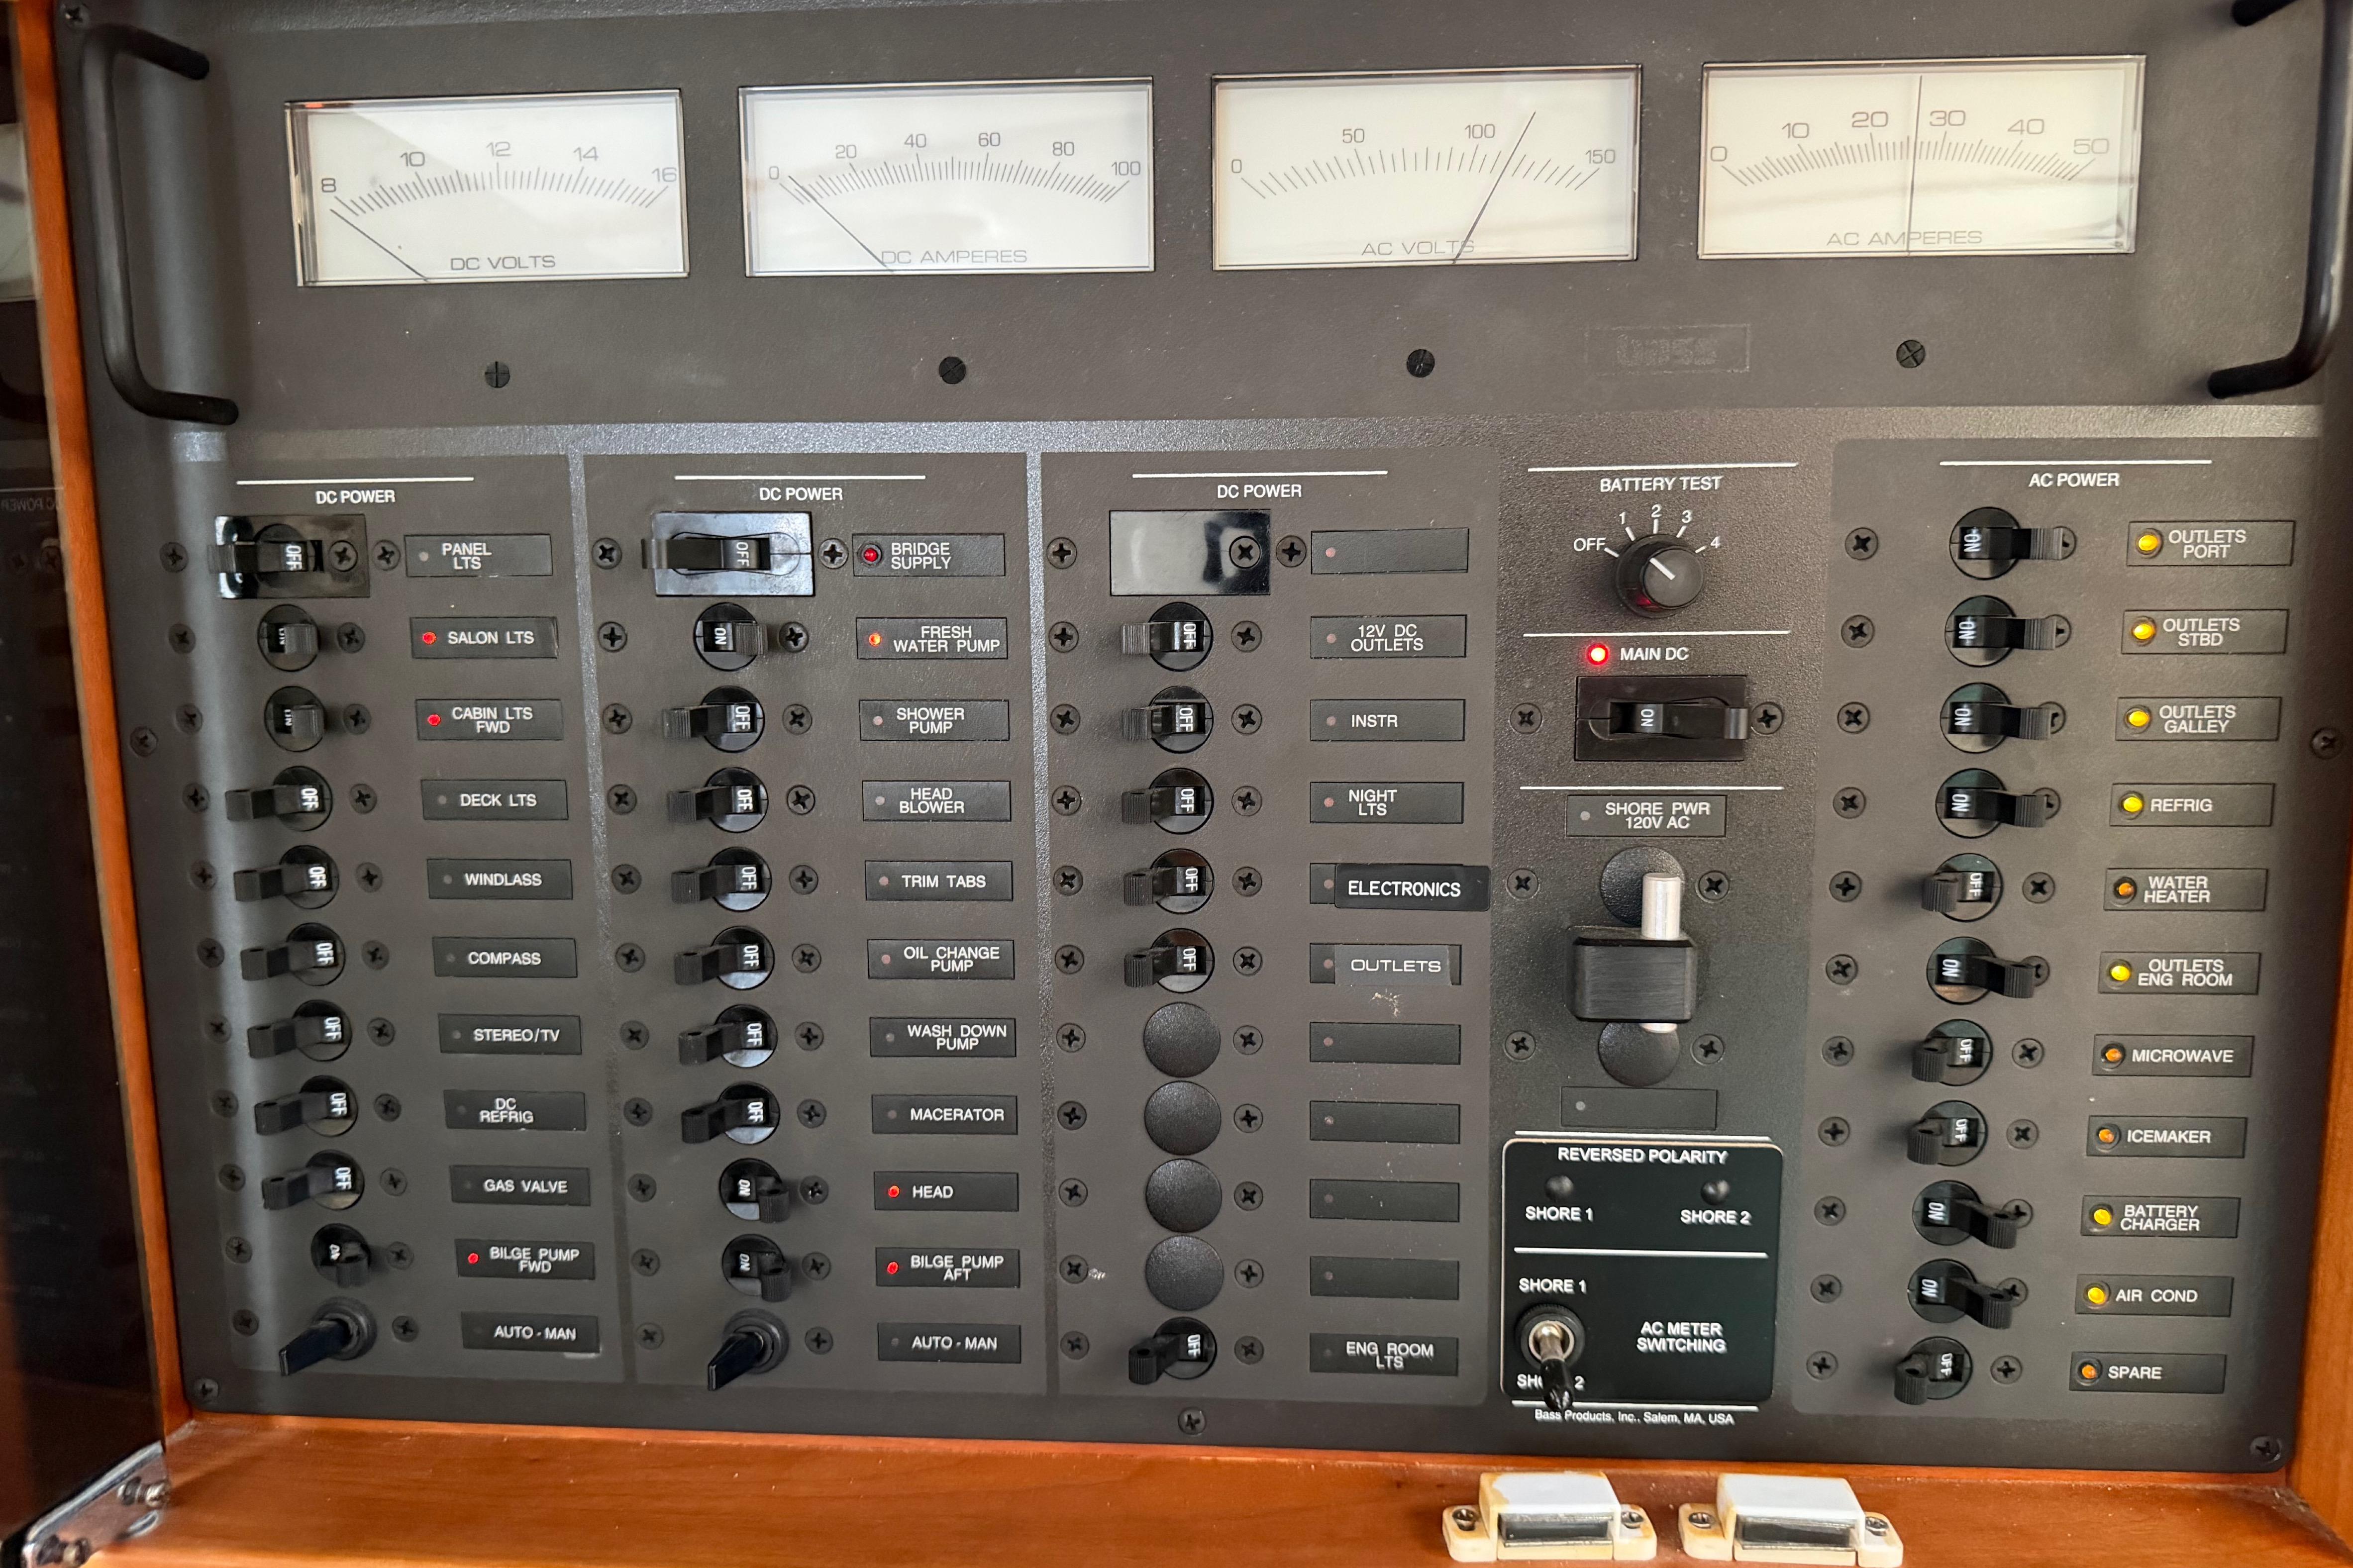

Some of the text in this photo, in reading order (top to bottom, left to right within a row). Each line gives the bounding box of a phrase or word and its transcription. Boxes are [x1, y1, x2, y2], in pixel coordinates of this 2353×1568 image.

[1851, 111, 1889, 128] 20
[1929, 110, 1966, 127] 30
[1464, 123, 1496, 139] 100
[1781, 122, 1810, 139] 10
[2007, 118, 2045, 135] 40
[904, 133, 927, 148] 40
[978, 132, 1001, 147] 60
[1342, 128, 1365, 144] 50
[486, 141, 511, 157] 12
[835, 144, 857, 159] 20
[1052, 141, 1075, 156] 80
[2073, 137, 2110, 155] 50
[400, 151, 425, 167] 10
[573, 146, 599, 162] 14
[1585, 148, 1617, 164] 150
[1710, 146, 1728, 162] 0
[769, 166, 780, 181] 0
[1111, 160, 1141, 176] 100
[1230, 159, 1242, 174] 0
[651, 167, 677, 183] 16
[320, 178, 337, 193] 8
[1826, 230, 1982, 246] AC AMPERES
[1361, 239, 1474, 256] AC VOLTS
[450, 255, 556, 271] DC VOLTS
[882, 250, 1027, 264] DC AMPERES
[1600, 476, 1723, 492] BATTERY TEST
[2029, 473, 2120, 488] AC POWER
[315, 490, 396, 504] DC POWER
[759, 487, 843, 501] DC POWER
[1217, 484, 1302, 498] DC POWER
[1619, 511, 1626, 525] 1
[1651, 504, 1661, 518] 2
[1681, 509, 1692, 523] 3
[1710, 536, 1721, 549] 4
[1964, 533, 1981, 552] ON
[2168, 529, 2247, 544] OUTLETS
[442, 542, 492, 556] PANEL
[891, 542, 950, 556] BRIDGE
[1573, 537, 1606, 552] OFF
[2183, 544, 2231, 559] PORT
[735, 542, 749, 567] OFF
[453, 556, 482, 570] LTS
[891, 556, 951, 570] SUPPLY
[1358, 623, 1417, 638] 12V DC
[2162, 617, 2240, 632] OUTLETS
[448, 631, 534, 644] SALON LTS
[715, 627, 727, 645] ON
[921, 625, 972, 639] FRESH
[1183, 622, 1196, 647] OFF
[893, 639, 1000, 652] WATER PUMP
[1350, 637, 1424, 652] OUTLETS
[2178, 633, 2223, 647] STBD
[1620, 647, 1689, 661] MAIN DC
[452, 706, 533, 720] CABIN LTS
[897, 707, 964, 720] SHOWER
[1179, 707, 1193, 731] OFF
[1640, 709, 1654, 727] ON
[2159, 705, 2236, 719] OUTLETS
[476, 720, 510, 733] FWD
[909, 721, 953, 734] PUMP
[1351, 714, 1398, 727] INSTR
[2164, 719, 2230, 734] GALLEY
[460, 793, 537, 807] DECK LTS
[911, 787, 952, 800] HEAD
[1181, 788, 1194, 812] OFF
[1349, 789, 1398, 802] NIGHT
[899, 800, 964, 814] BLOWER
[1358, 802, 1387, 816] LTS
[1605, 802, 1710, 815] SHORE PWR
[2150, 798, 2213, 812] REFRIG
[1626, 815, 1690, 829] 120V AC
[465, 873, 542, 886] WINDLASS
[901, 875, 986, 888] TRIM TABS
[2148, 876, 2208, 889] WATER
[1348, 880, 1461, 897] ELECTRONICS
[2144, 890, 2210, 903] HEATER
[468, 951, 541, 965] COMPASS
[904, 946, 1000, 960] OIL CHANGE
[931, 959, 974, 972] PUMP
[1351, 959, 1441, 973] OUTLETS
[2148, 959, 2224, 973] OUTLETS
[2138, 973, 2233, 986] ENG ROOM
[473, 1028, 560, 1042] STEREO/TV
[907, 1024, 1007, 1038] WASH DOWN
[936, 1037, 979, 1051] PUMP
[2132, 1049, 2234, 1063] MICROWAVE
[495, 1097, 516, 1110] DC
[480, 1110, 533, 1123] REFRIG
[911, 1108, 1004, 1121] MACERATOR
[2127, 1129, 2211, 1144] ICEMAKER
[1558, 1147, 1728, 1164] REVERSED POLARITY
[484, 1179, 568, 1193] GAS VALVE
[913, 1185, 953, 1198] HEAD
[1526, 1206, 1593, 1221] SHORE 1
[1680, 1209, 1751, 1225] SHORE 2
[2124, 1204, 2198, 1218] BATTERY
[2120, 1217, 2200, 1231] CHARGER
[490, 1246, 580, 1262] BILGE PUMP
[519, 1260, 552, 1273] FWD
[911, 1255, 1004, 1269] BILGE PUMP
[943, 1269, 972, 1280] AFT
[1519, 1277, 1586, 1293] SHORE 1
[2115, 1289, 2198, 1302] AIR COND
[1640, 1321, 1722, 1337] AC METER
[1346, 1341, 1433, 1358] ENG ROOM
[1637, 1337, 1726, 1353] SWITCHING
[1375, 1356, 1404, 1369] LTS
[2108, 1366, 2162, 1379] SPARE
[1574, 1375, 1584, 1390] 2
[1535, 1409, 1562, 1421] Bass
[1708, 1413, 1735, 1425] USA
